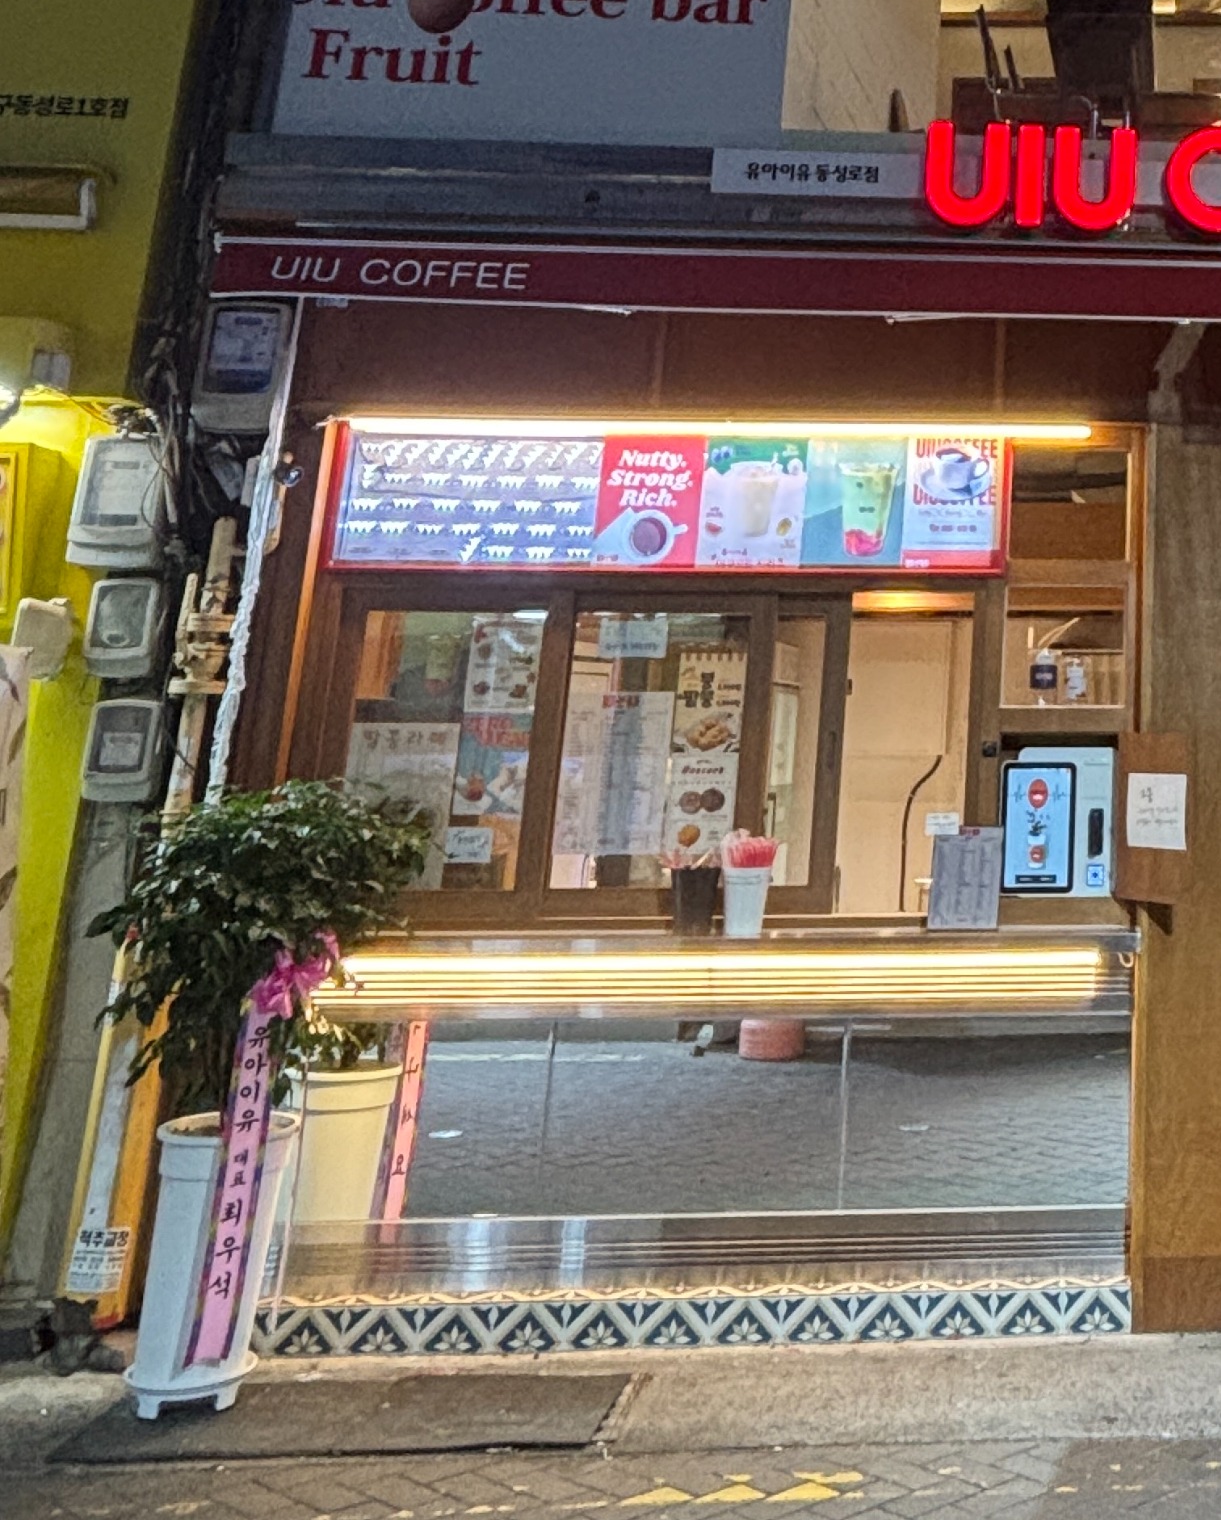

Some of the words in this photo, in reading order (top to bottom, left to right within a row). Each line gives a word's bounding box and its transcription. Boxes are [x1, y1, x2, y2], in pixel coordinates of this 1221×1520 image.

[301, 27, 482, 87] Fruit
[745, 161, 811, 182] 유아이유
[815, 163, 879, 184] 동성로점
[925, 119, 1138, 232] UIU
[271, 256, 342, 282] UIU
[360, 259, 531, 291] COFFEE
[618, 449, 688, 471] Nutty.
[606, 469, 693, 491] Strong.
[618, 488, 678, 507] Rich.
[236, 1025, 270, 1133] 유아이유
[229, 1149, 250, 1188] 대표
